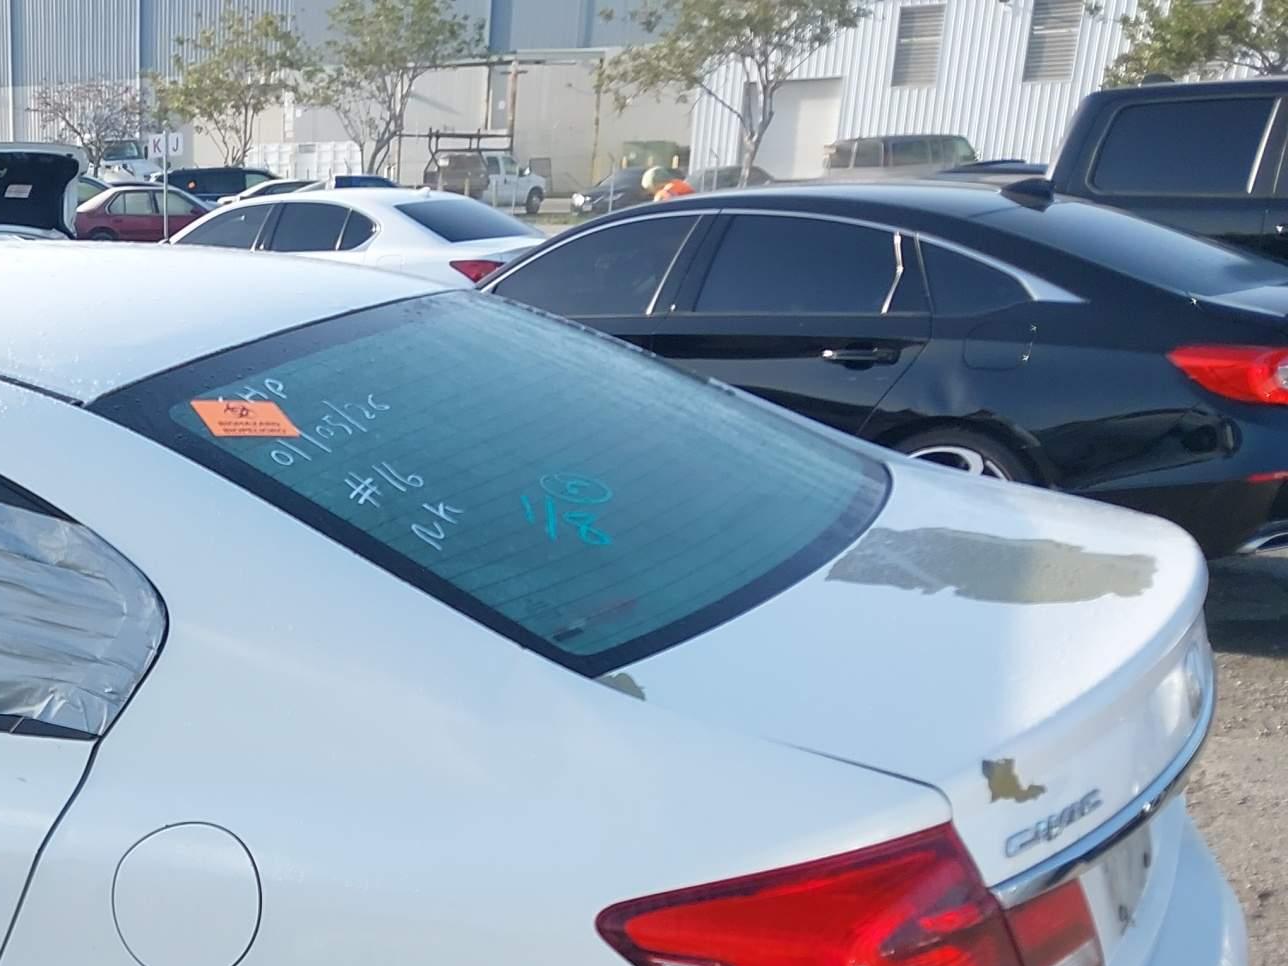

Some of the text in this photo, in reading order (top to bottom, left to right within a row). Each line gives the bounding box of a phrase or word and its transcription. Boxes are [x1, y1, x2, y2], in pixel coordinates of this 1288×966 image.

[152, 138, 162, 153] K
[172, 136, 179, 152] J
[218, 377, 288, 403] HP
[344, 461, 424, 508] #16
